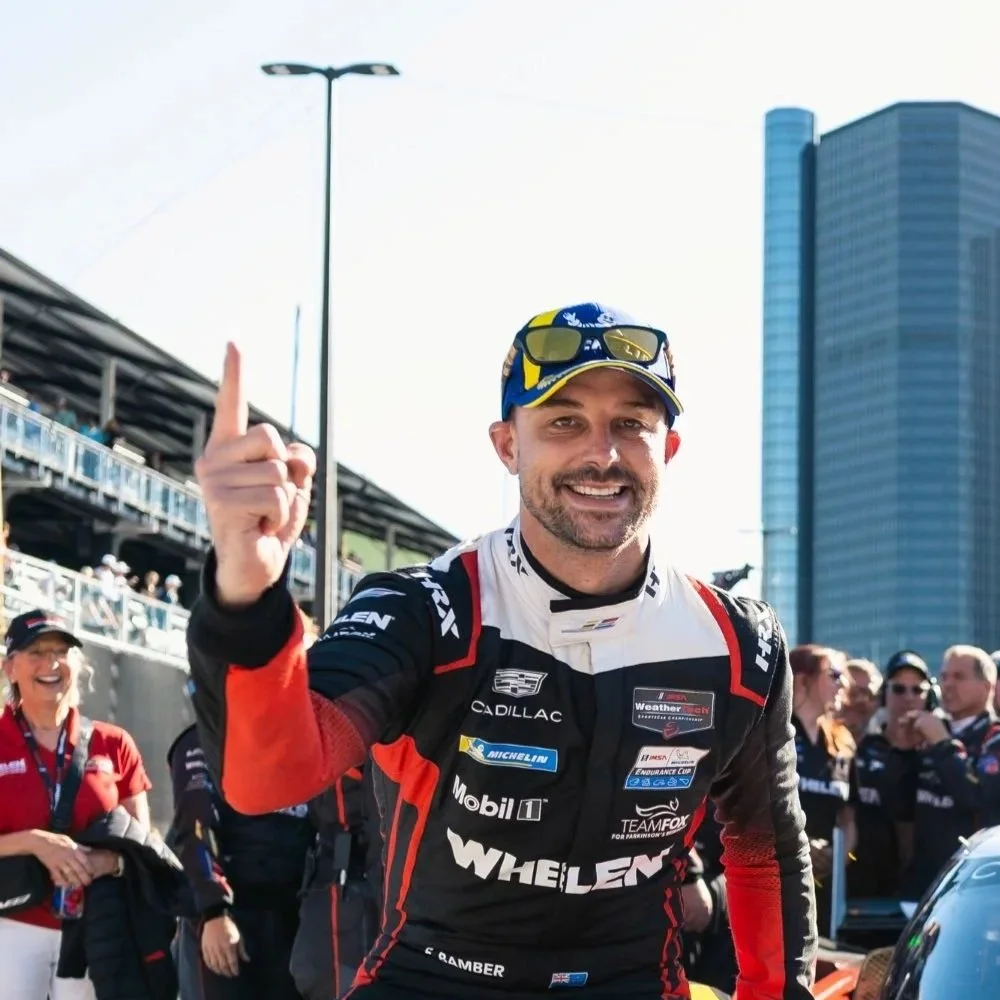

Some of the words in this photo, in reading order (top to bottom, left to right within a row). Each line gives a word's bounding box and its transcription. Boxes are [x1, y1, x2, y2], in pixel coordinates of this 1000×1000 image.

[471, 700, 563, 723] CADILLAC
[486, 750, 549, 764] MICHELIN
[635, 768, 676, 776] ENDURANCE
[677, 767, 692, 775] CUP
[452, 774, 515, 820] Mobil
[621, 814, 691, 834] TEAMFOX
[611, 833, 625, 841] FOR
[447, 827, 675, 895] WHELEN
